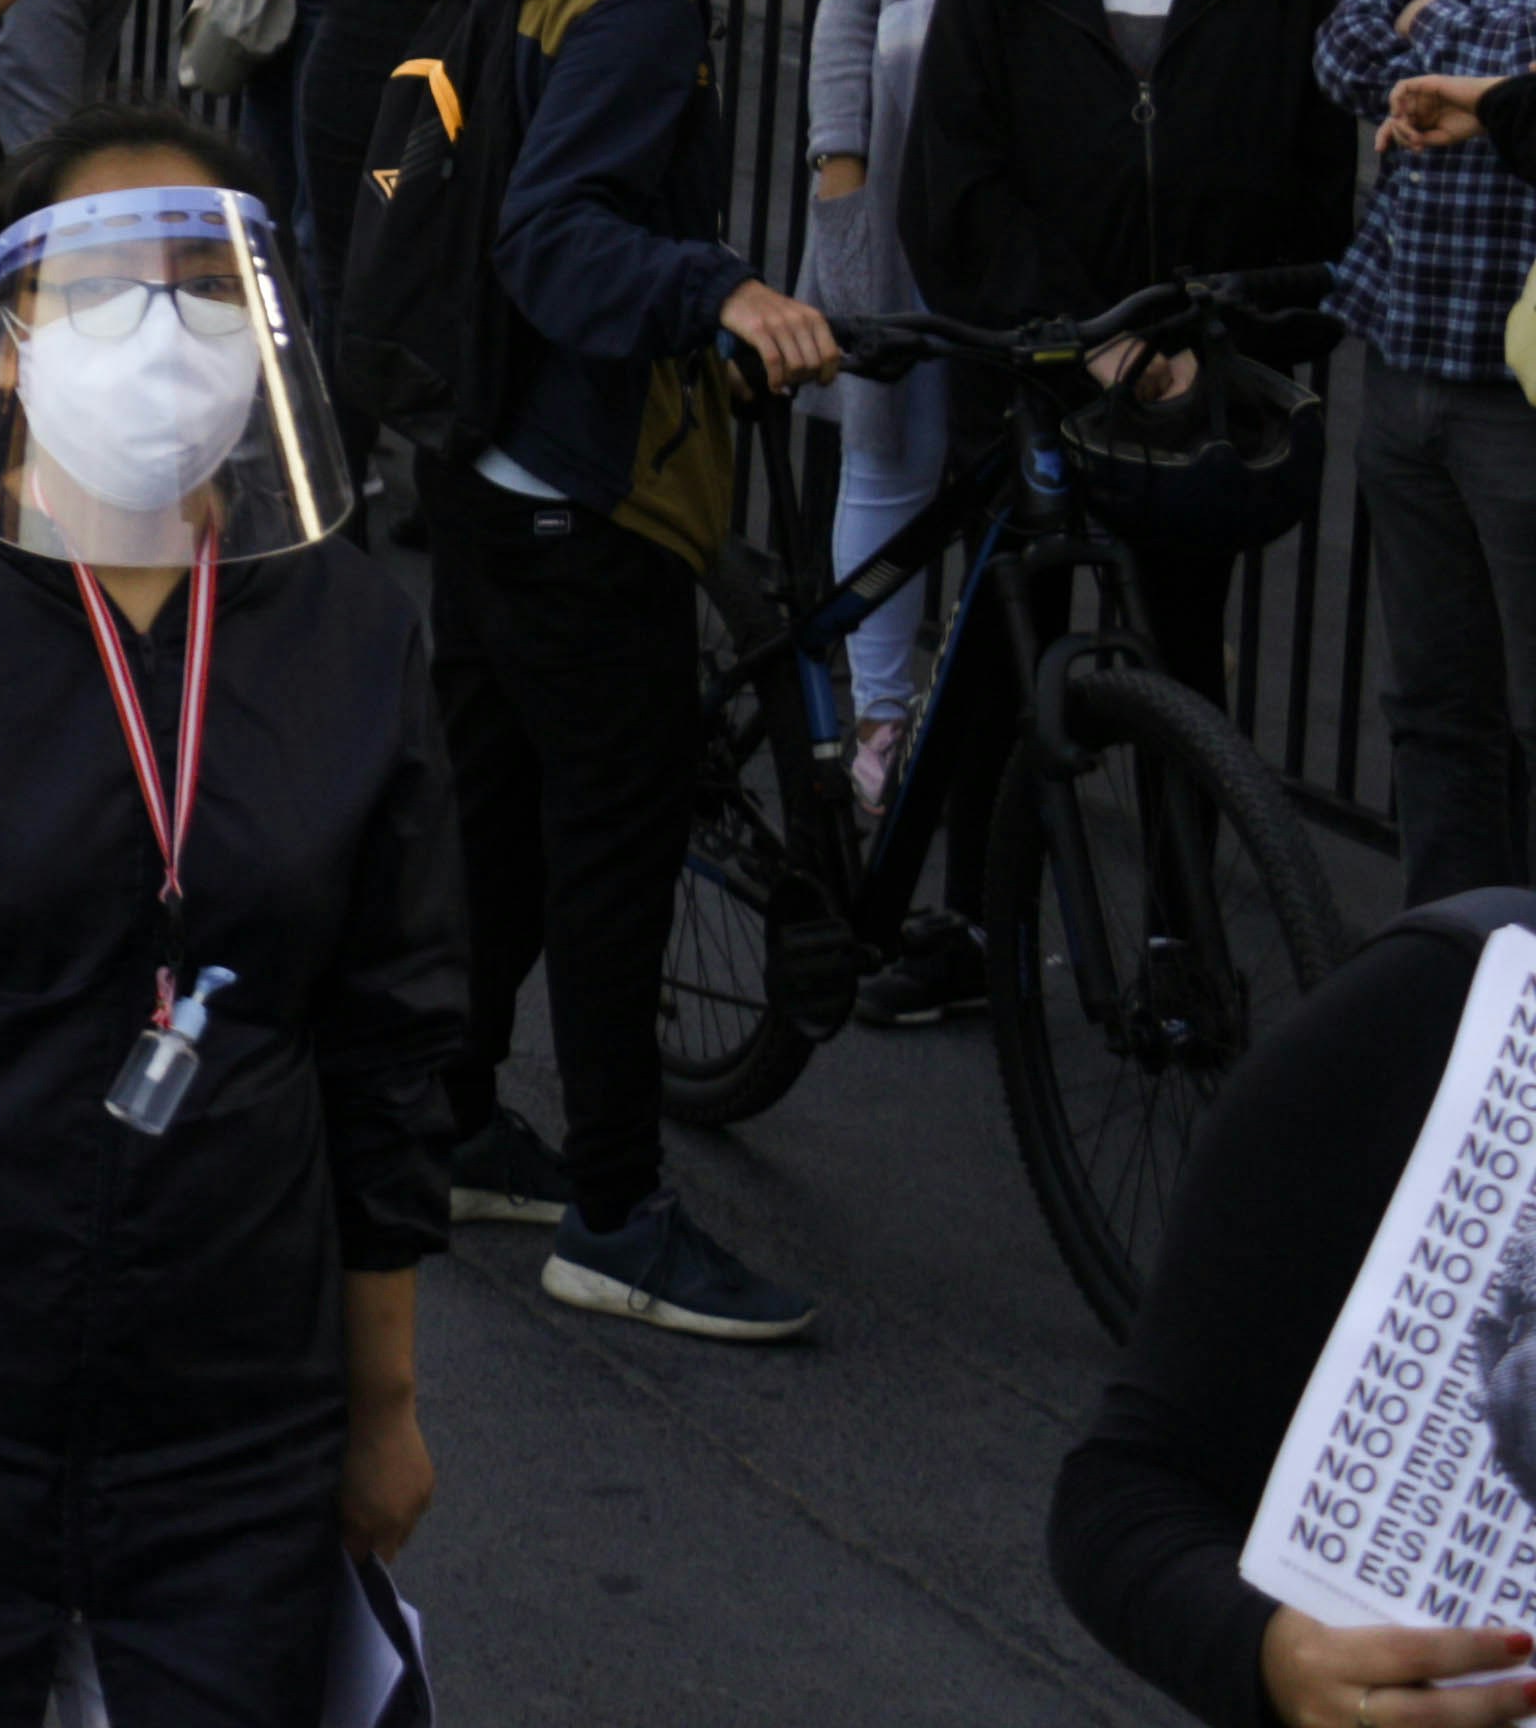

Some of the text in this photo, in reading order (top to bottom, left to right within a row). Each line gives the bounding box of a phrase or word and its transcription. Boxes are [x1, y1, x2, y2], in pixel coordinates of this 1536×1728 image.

[1499, 1035, 1536, 1075] N
[1473, 1099, 1533, 1146] NO
[1458, 1132, 1518, 1181] NO
[1443, 1168, 1504, 1215] NO
[1427, 1202, 1489, 1249] NO
[1410, 1237, 1474, 1284] NO
[1394, 1273, 1457, 1320] NO
[1379, 1308, 1441, 1355] NO
[1362, 1344, 1488, 1422] NO ES
[1346, 1378, 1473, 1458] NO ES
[1331, 1411, 1394, 1459] NO
[1402, 1445, 1458, 1492] ES
[1466, 1477, 1515, 1522] MI
[1315, 1445, 1377, 1494] NO
[1386, 1481, 1443, 1527] ES
[1450, 1512, 1502, 1557] MI
[1302, 1480, 1361, 1529] NO
[1371, 1517, 1426, 1563] ES
[1434, 1548, 1486, 1593] MI
[1290, 1515, 1346, 1564] NO
[1356, 1552, 1410, 1598] ES
[1418, 1584, 1470, 1628] MI
